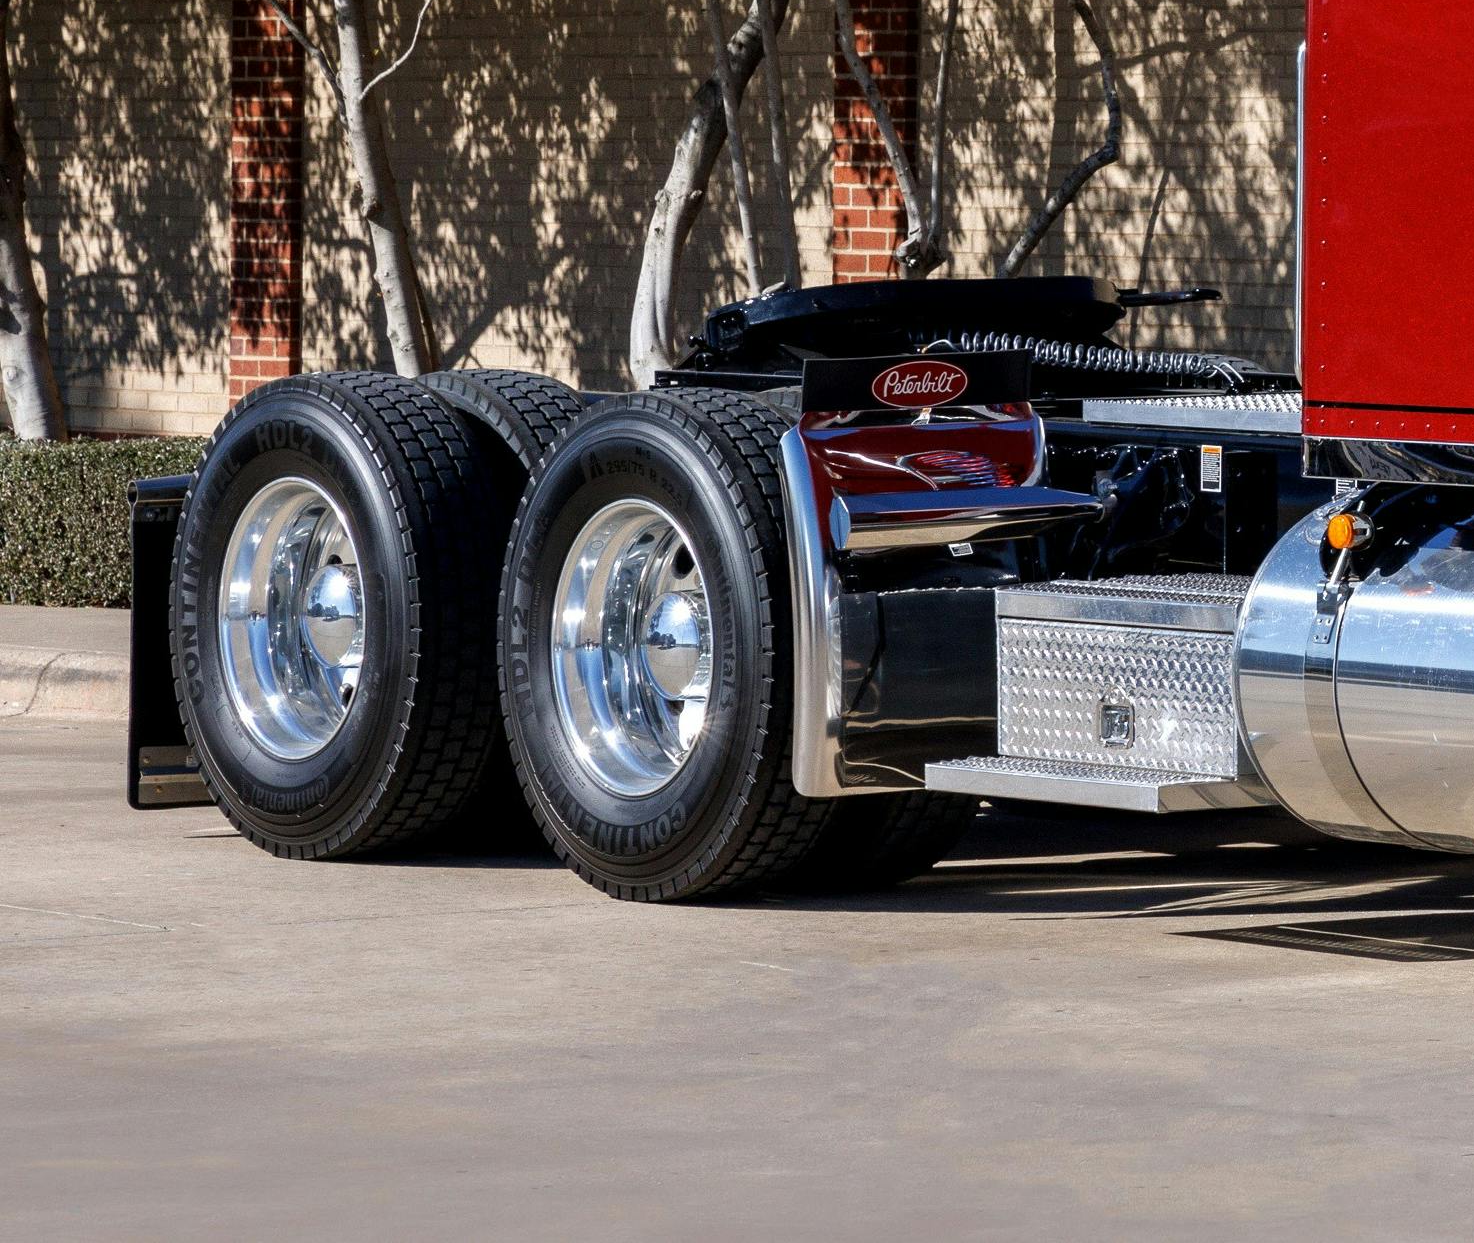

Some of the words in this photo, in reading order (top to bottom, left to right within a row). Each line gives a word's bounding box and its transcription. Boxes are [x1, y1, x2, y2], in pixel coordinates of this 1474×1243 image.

[883, 370, 961, 398] Peterbilt
[253, 418, 315, 455] HDL2
[510, 604, 535, 723] HDL2
